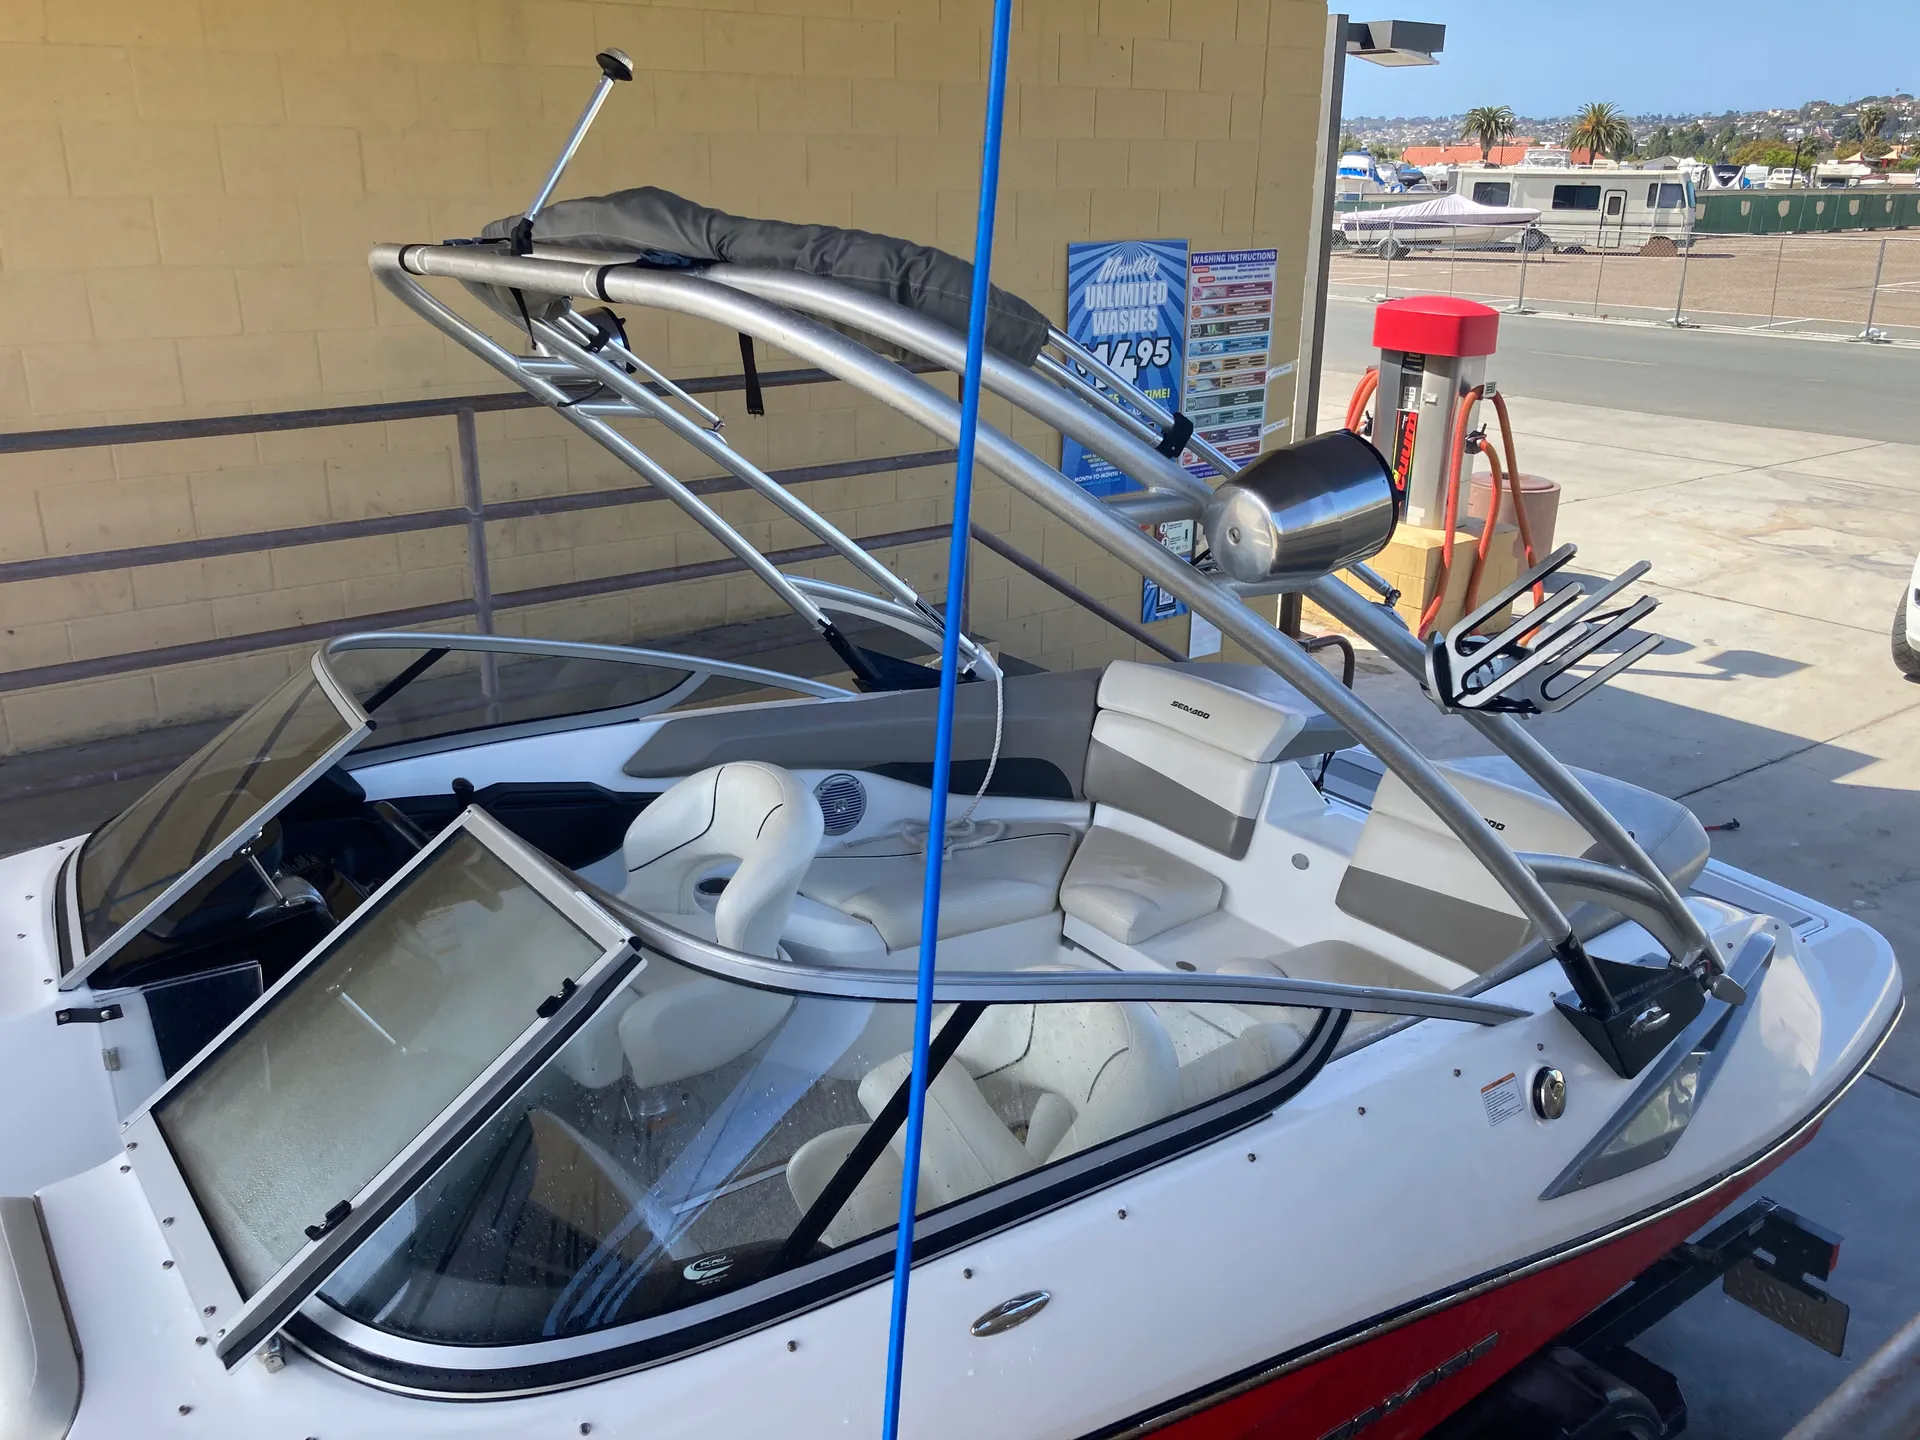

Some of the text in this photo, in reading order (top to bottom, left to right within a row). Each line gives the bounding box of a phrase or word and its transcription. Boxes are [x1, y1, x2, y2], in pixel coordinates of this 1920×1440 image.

[1096, 255, 1159, 283] Monthly
[1193, 251, 1276, 264] WASHING INSTRUCTIONS
[1085, 281, 1167, 310] UNLIMITED
[1092, 308, 1158, 336] WASHES
[1143, 388, 1171, 400] TIME!
